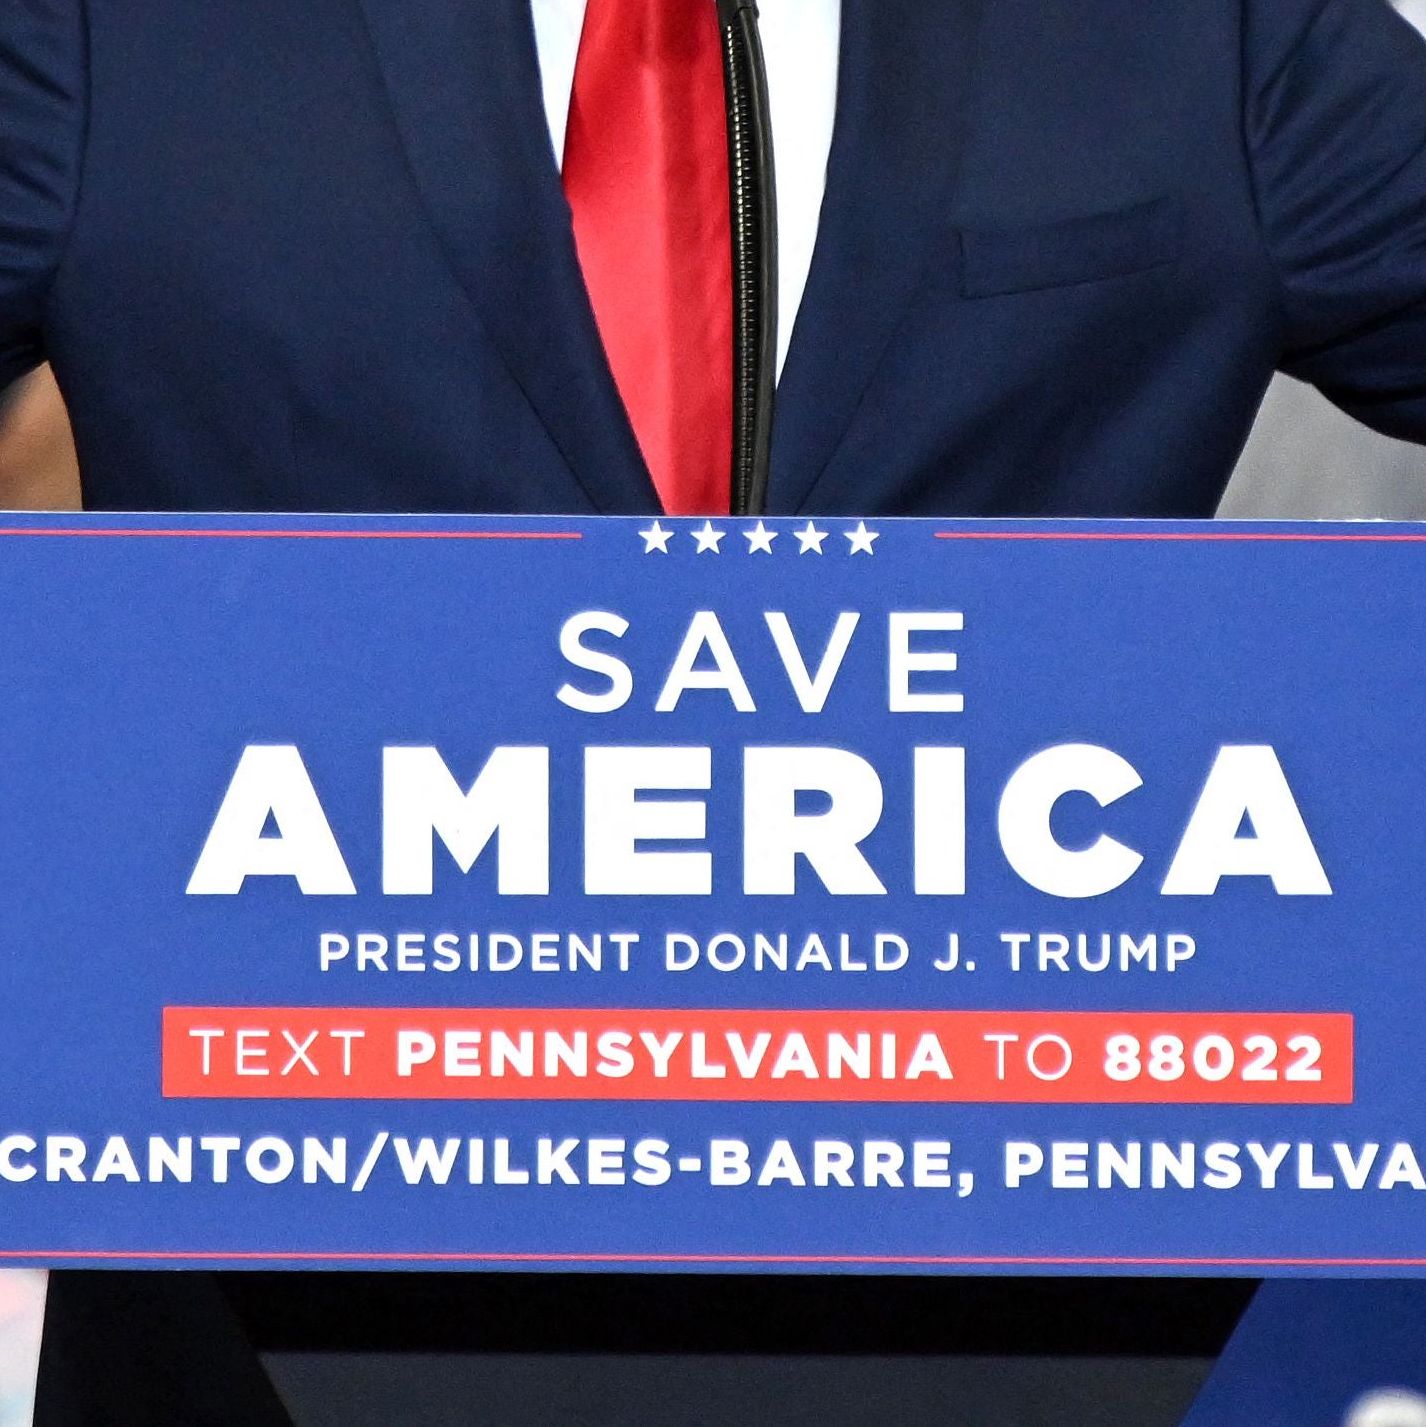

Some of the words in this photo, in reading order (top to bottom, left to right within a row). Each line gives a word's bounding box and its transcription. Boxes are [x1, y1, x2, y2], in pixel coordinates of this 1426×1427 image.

[554, 609, 965, 713] SAVE
[184, 742, 1333, 898] AMERICA
[319, 931, 640, 972] PRESIDENT
[664, 931, 909, 972] DONALD
[932, 931, 976, 972] J.
[999, 931, 1196, 972] TRUMP
[187, 1028, 366, 1076] TEXT
[396, 1028, 954, 1080] PENNSYLVANIA
[982, 1032, 1073, 1081] TO
[1102, 1032, 1323, 1082] 88022
